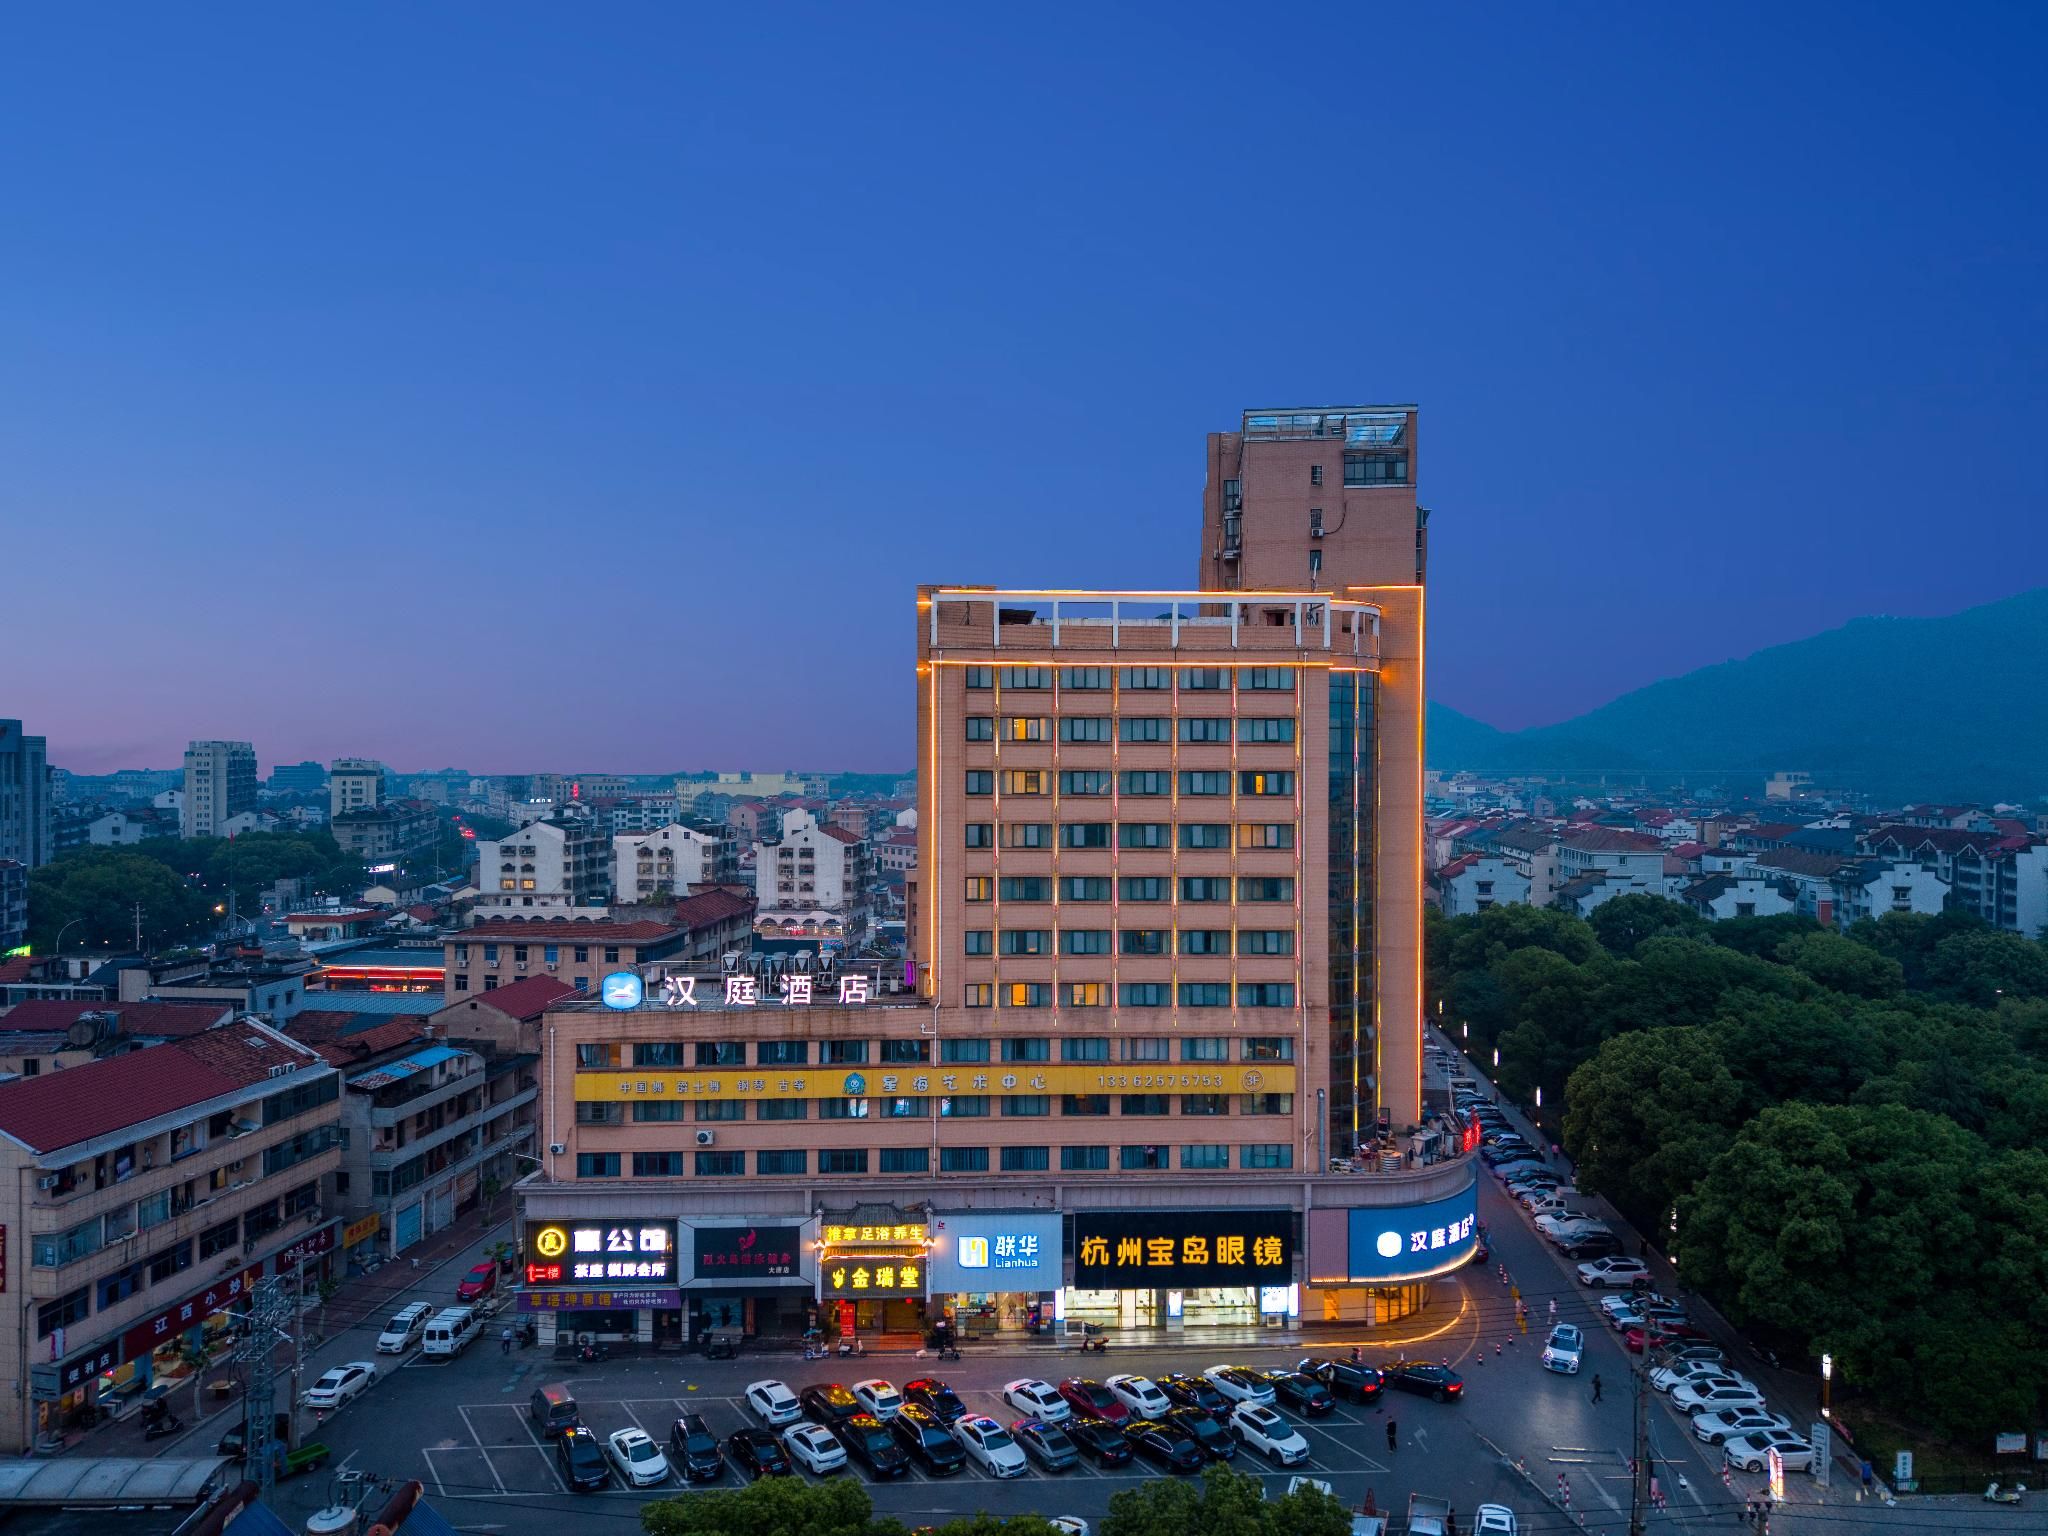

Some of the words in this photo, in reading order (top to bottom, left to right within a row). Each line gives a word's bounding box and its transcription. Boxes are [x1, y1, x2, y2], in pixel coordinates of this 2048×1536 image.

[666, 974, 869, 1006] 汉庭酒店
[618, 1080, 665, 1095] 中国舞
[676, 1080, 721, 1094] 爵士舞
[736, 1079, 767, 1093] 钢琴
[777, 1078, 806, 1092] 古筝
[882, 1074, 1047, 1093] 星海艺术中心
[995, 1235, 1039, 1257] 联华
[1410, 1218, 1470, 1252] 汉庭酒店
[1080, 1235, 1284, 1267] 杭州宝岛眼镜
[534, 1265, 560, 1279] 二楼
[995, 1258, 1038, 1268] Lianhua
[851, 1266, 920, 1289] 金瑞堂
[68, 1351, 112, 1384] 便利店
